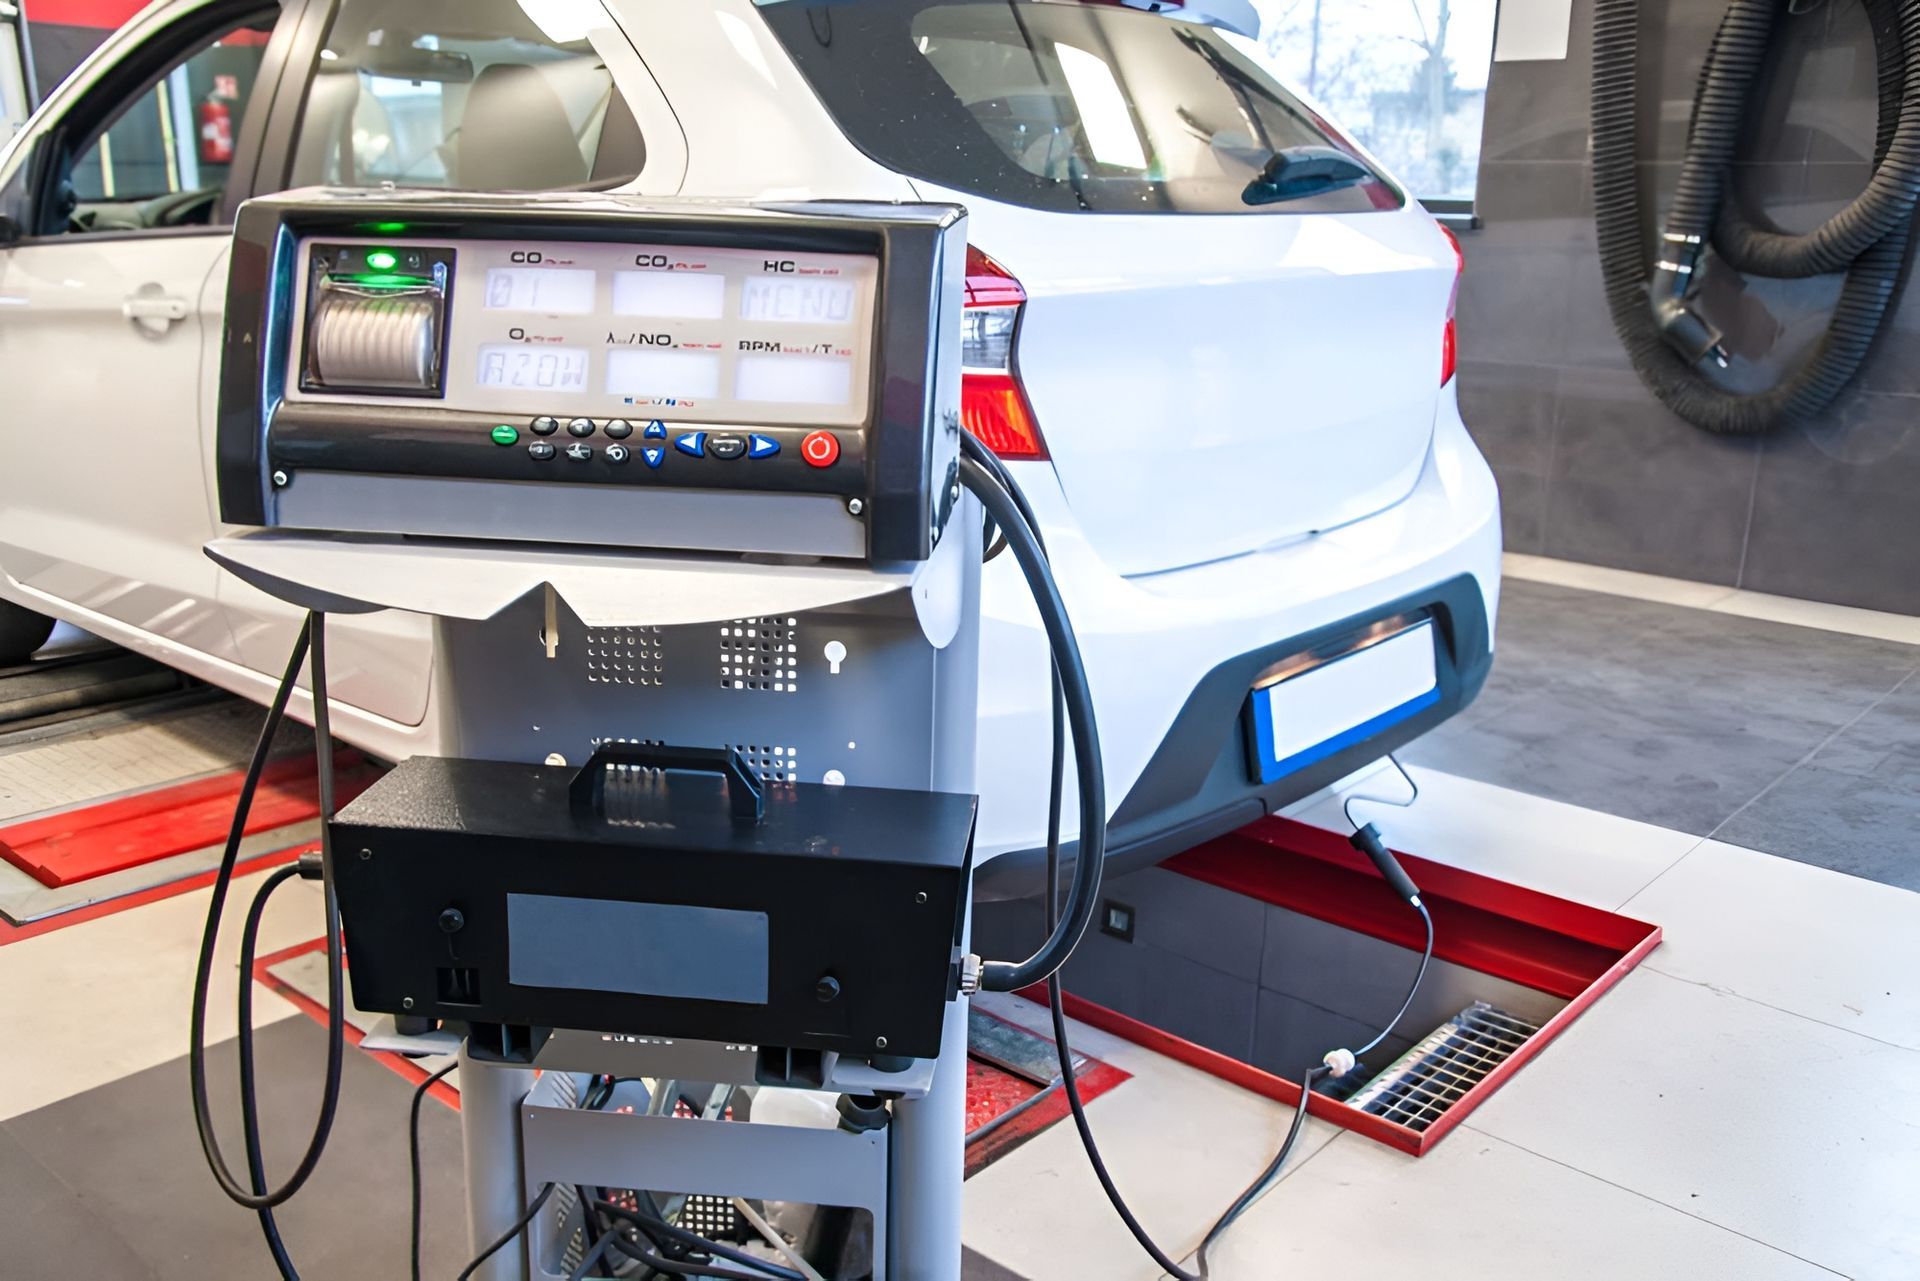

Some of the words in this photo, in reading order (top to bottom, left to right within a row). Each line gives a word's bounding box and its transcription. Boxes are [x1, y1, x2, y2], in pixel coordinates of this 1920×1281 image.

[511, 251, 542, 263] CO
[763, 260, 795, 273] HC
[738, 340, 781, 353] RPM
